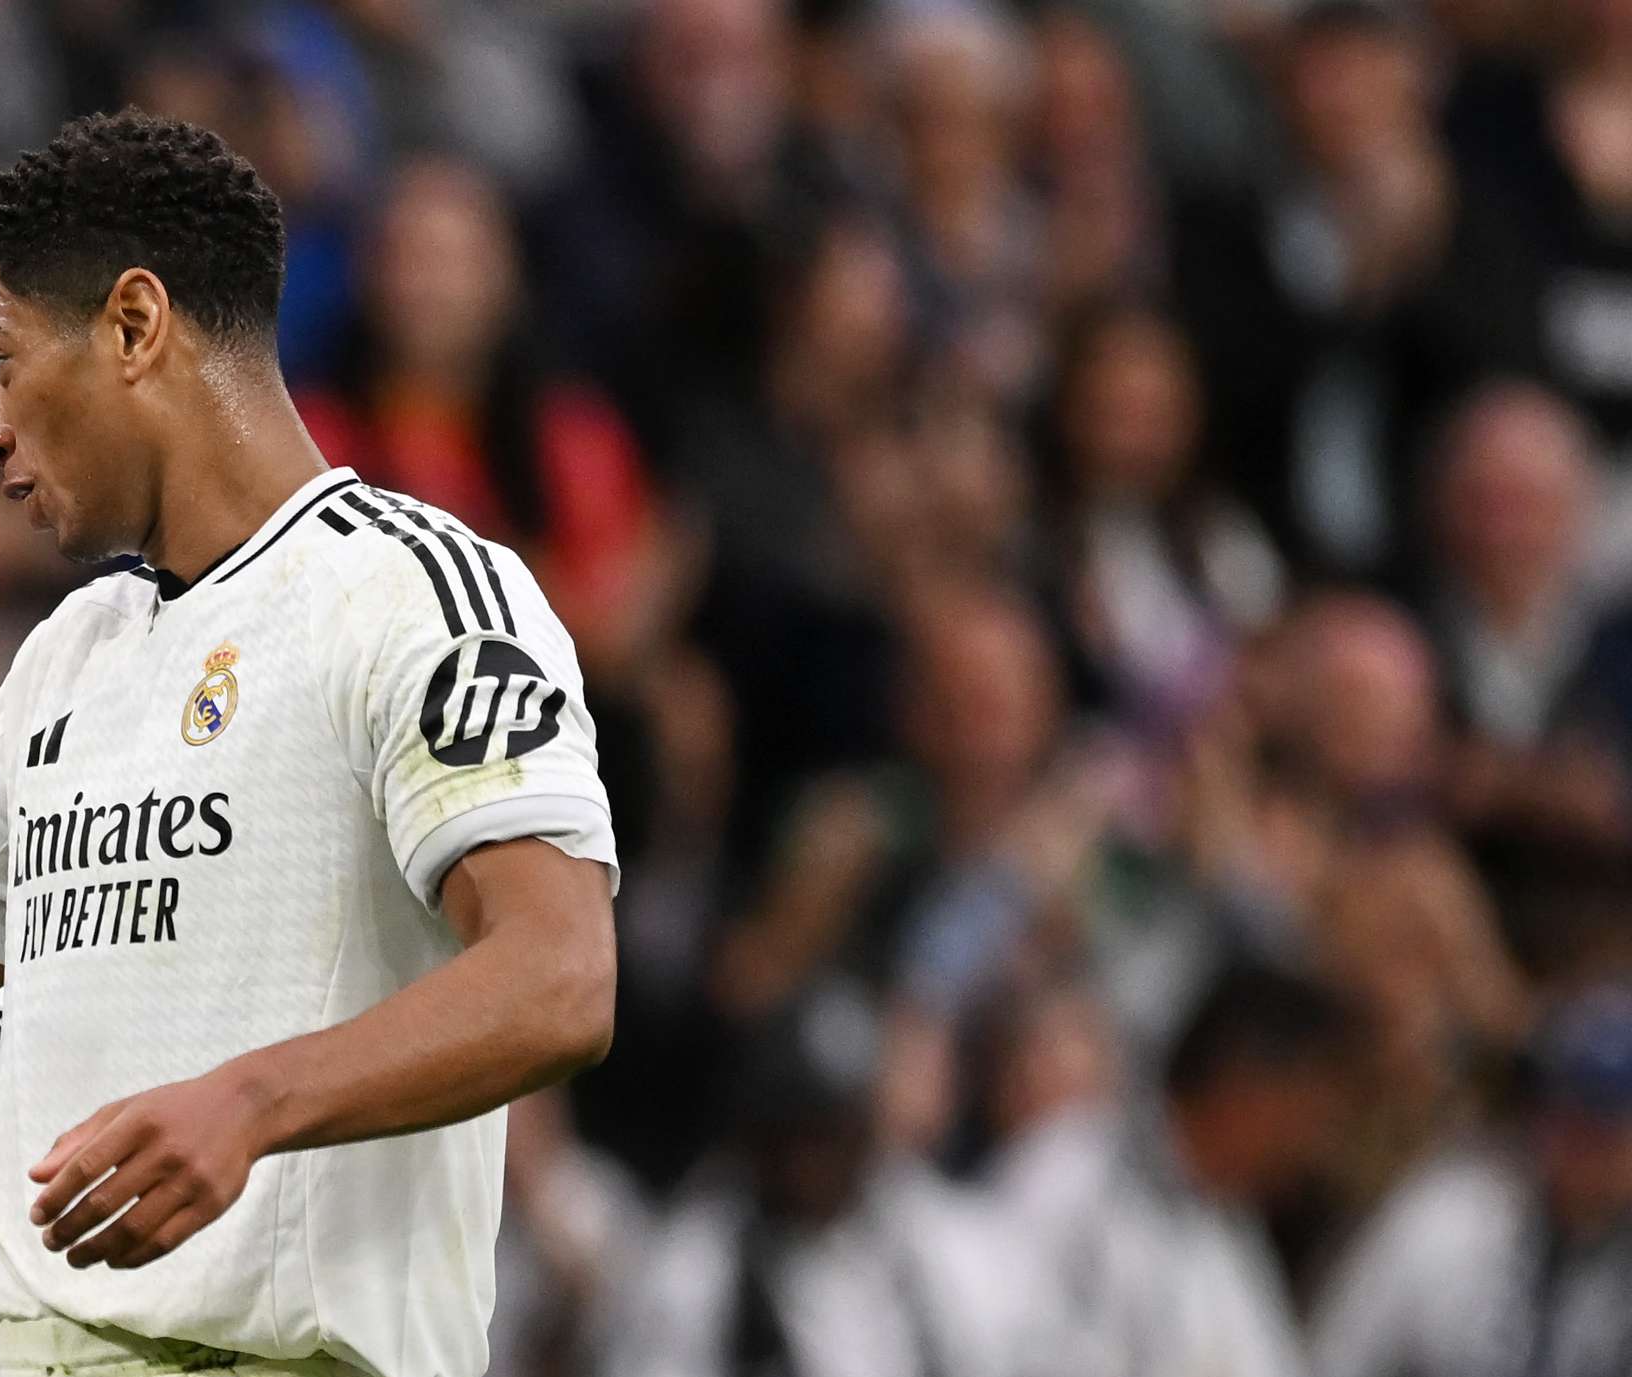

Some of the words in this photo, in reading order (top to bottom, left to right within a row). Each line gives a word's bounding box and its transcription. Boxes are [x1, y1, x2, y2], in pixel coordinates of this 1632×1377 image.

[430, 640, 564, 765] hp
[20, 893, 53, 963] FLY
[55, 877, 179, 952] BETTER
